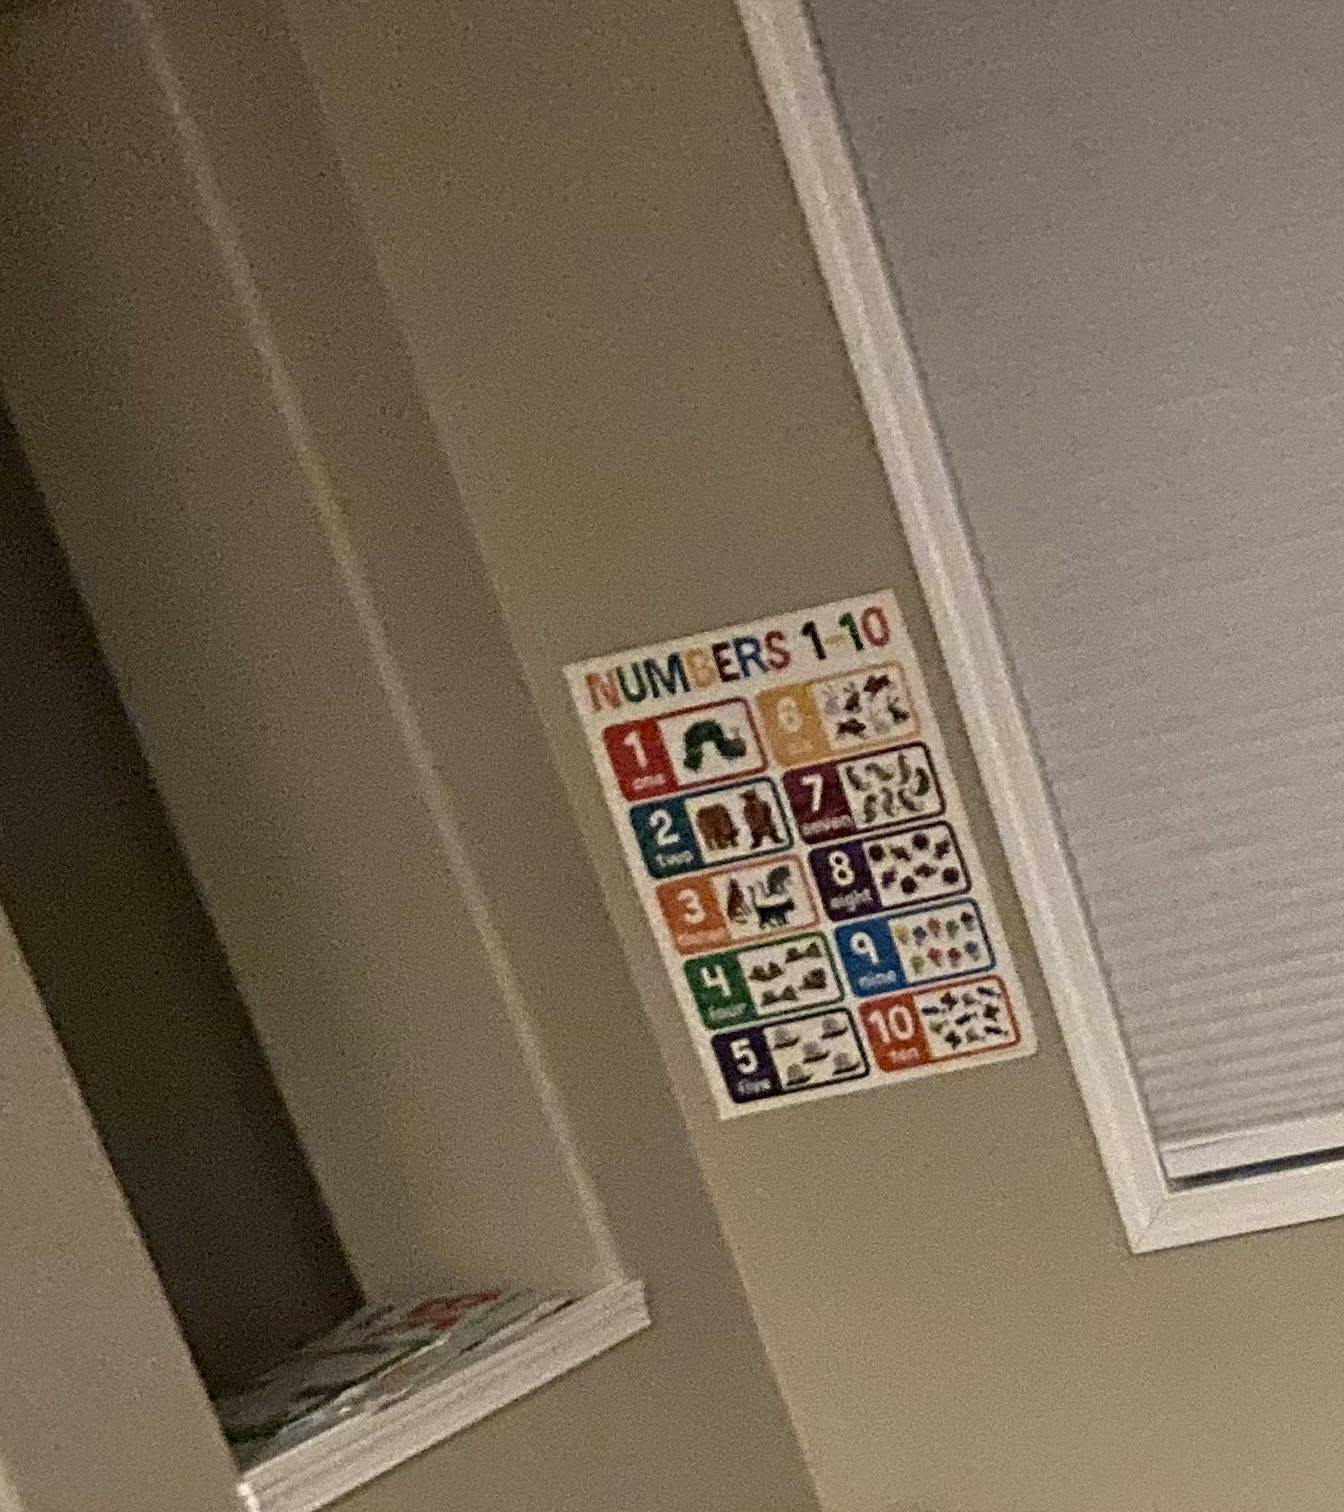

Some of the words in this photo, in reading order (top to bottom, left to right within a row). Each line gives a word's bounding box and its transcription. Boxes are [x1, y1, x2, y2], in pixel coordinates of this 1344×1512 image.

[584, 630, 792, 710] NUMBERS
[624, 731, 649, 768] 1
[801, 773, 823, 813] 7
[649, 809, 681, 846] 2
[828, 851, 854, 887] 8
[677, 888, 707, 924] 3
[850, 931, 880, 965] 9
[701, 964, 731, 998] 4
[868, 1004, 916, 1044] 10
[729, 1038, 758, 1074] 5
